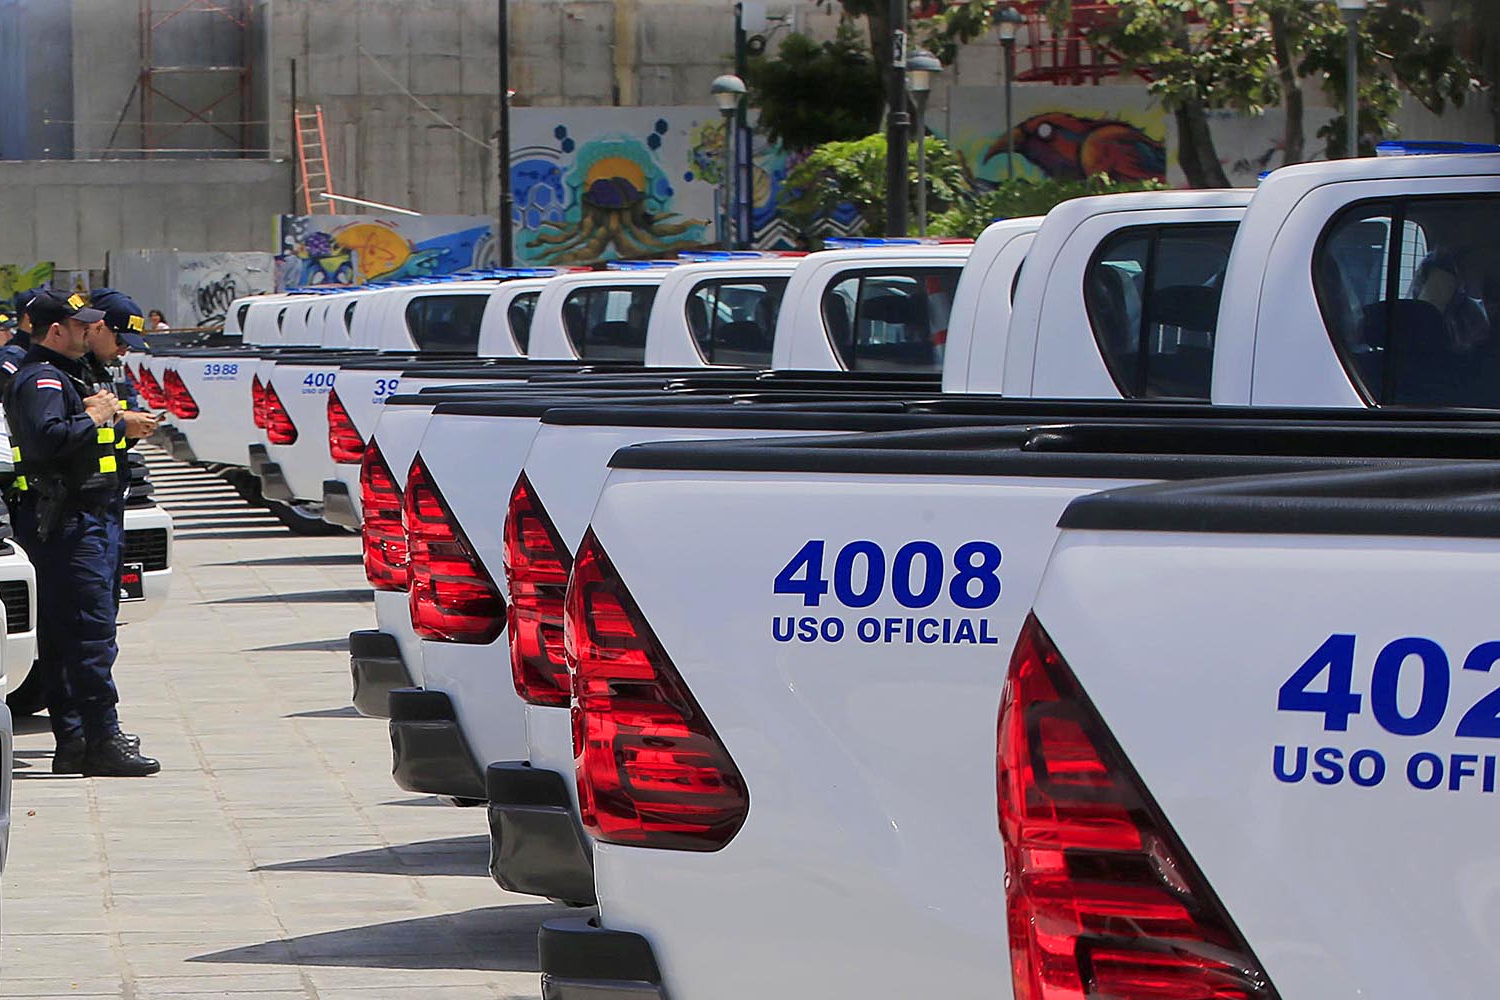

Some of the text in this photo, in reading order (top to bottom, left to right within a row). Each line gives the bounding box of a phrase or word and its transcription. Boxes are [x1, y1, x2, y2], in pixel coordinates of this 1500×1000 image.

[203, 363, 238, 375] 3988
[303, 372, 336, 387] 400
[773, 540, 1003, 609] 4008
[772, 617, 999, 645] USO OFICIAL
[1277, 633, 1500, 739] 402
[1273, 745, 1496, 793] USO OFI
